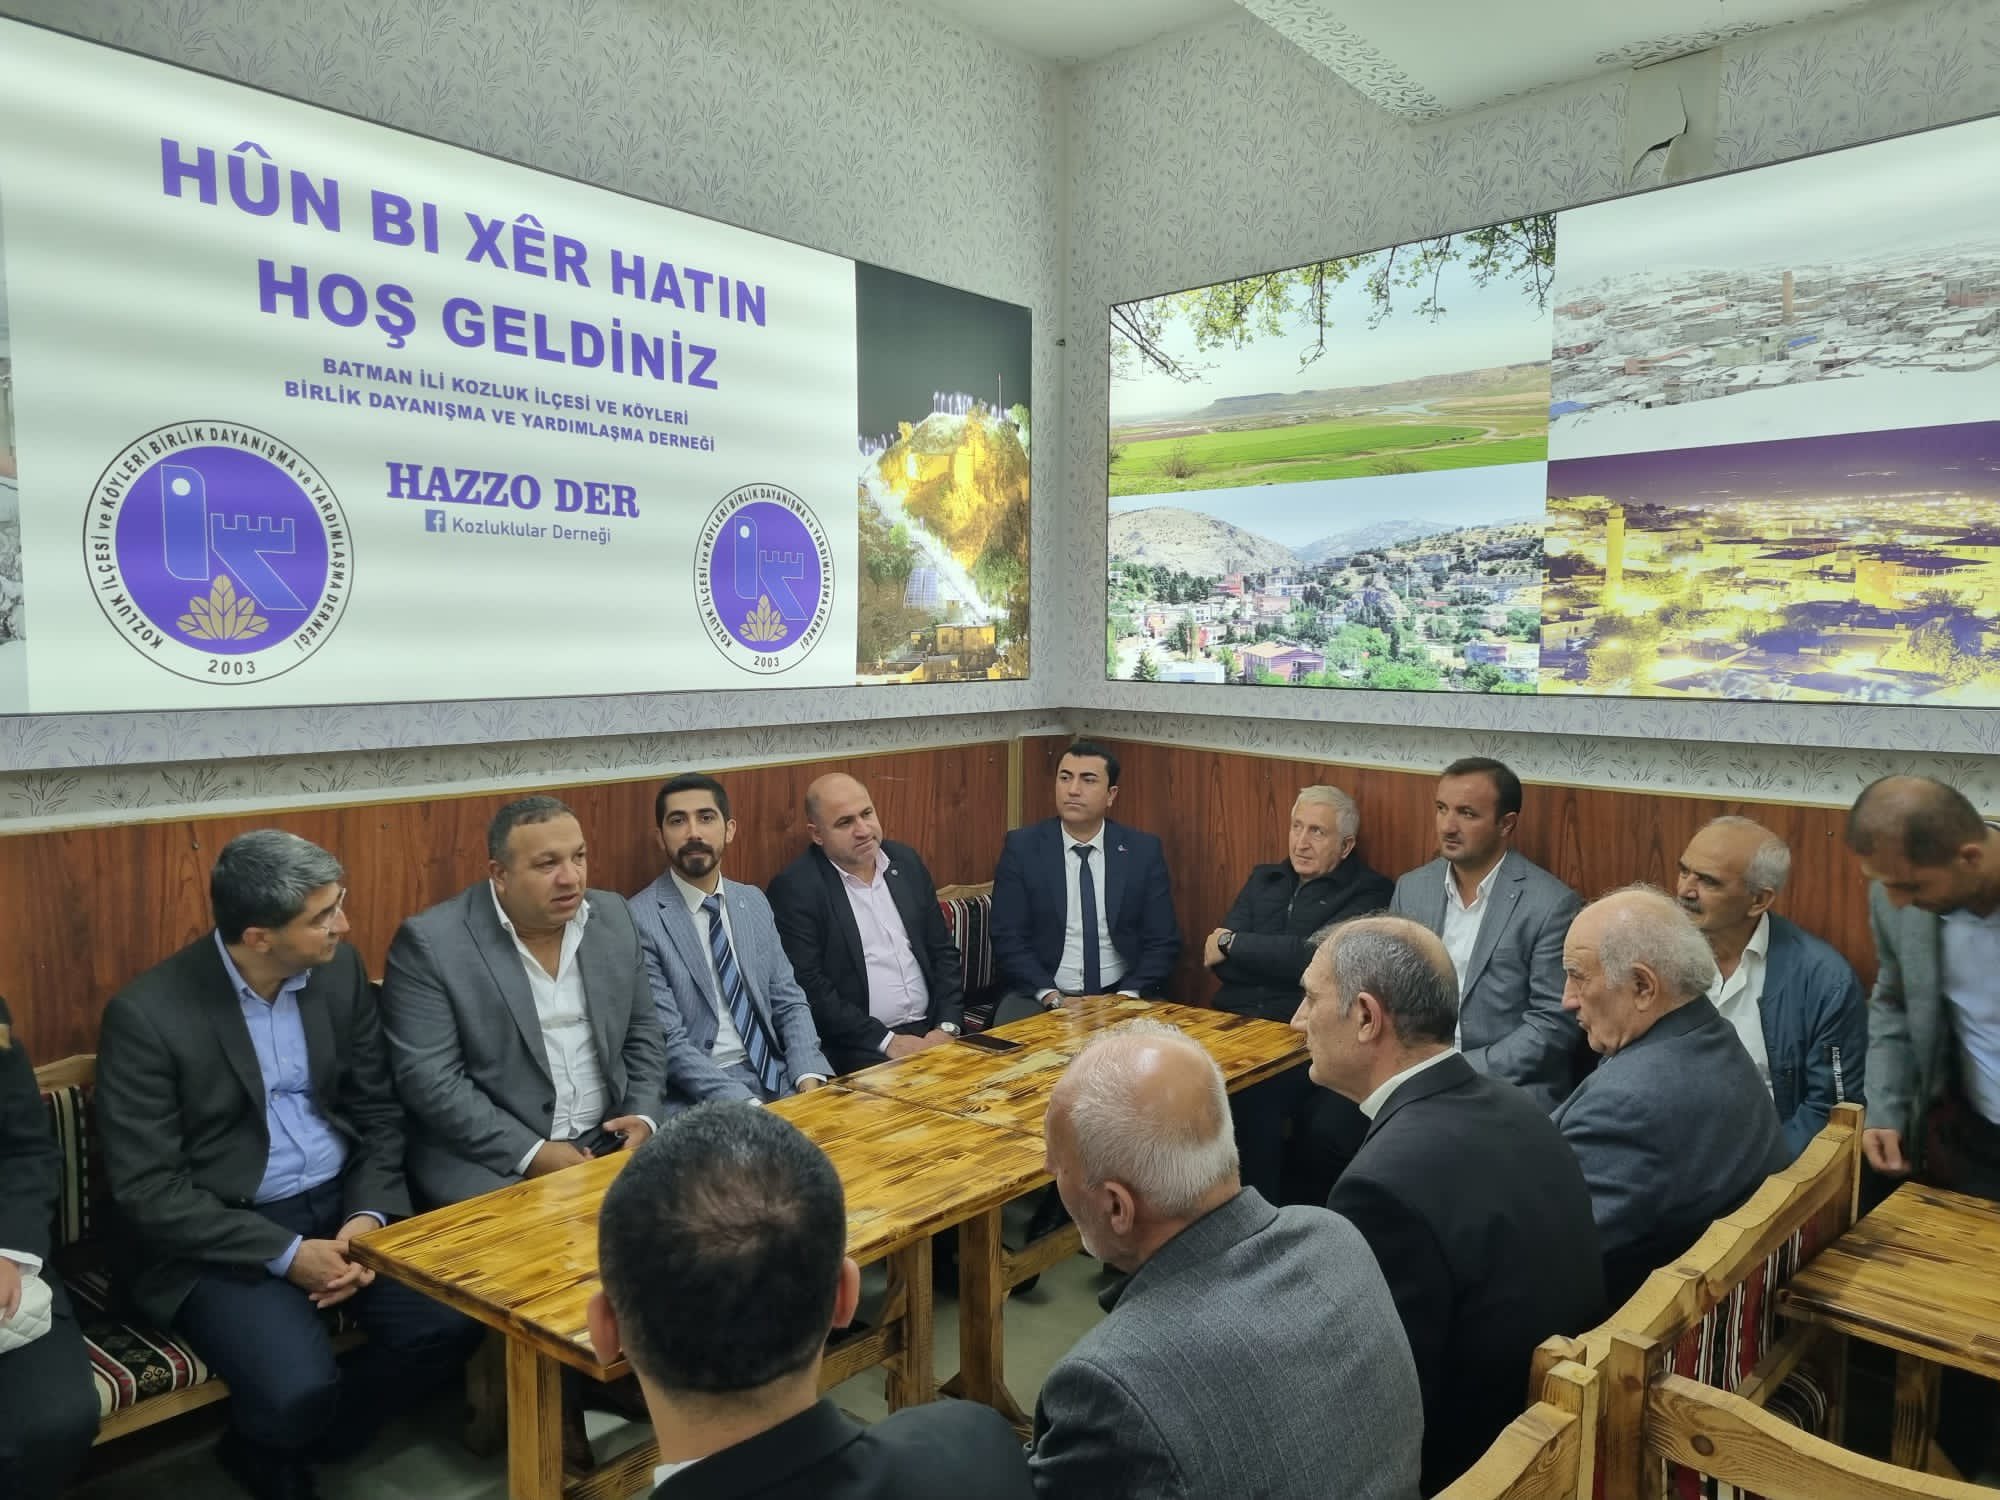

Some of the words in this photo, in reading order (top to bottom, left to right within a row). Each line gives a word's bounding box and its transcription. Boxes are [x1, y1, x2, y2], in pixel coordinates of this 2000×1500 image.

[160, 137, 341, 233] HÛN
[371, 189, 439, 254] BI
[464, 212, 592, 288] XÊR
[611, 249, 766, 328] HATIN
[258, 258, 417, 349] HOŞ
[442, 297, 719, 391] GELDİNİZ
[285, 379, 362, 406] BİRLİK
[369, 392, 486, 422] DAYANIŞMA
[491, 409, 516, 426] VE
[522, 413, 644, 442] YARDIMLAŞMA
[649, 431, 715, 452] DERNEĞİ
[323, 357, 413, 385] BATMAN
[420, 369, 445, 390] İLİ
[452, 377, 529, 402] KOZLUK
[535, 387, 591, 411] İLÇESİ
[596, 399, 617, 415] VE
[622, 403, 689, 426] KÖYLERİ
[149, 425, 205, 455] BİRLİK
[210, 428, 296, 470] DAYANIŞMA
[100, 446, 151, 510] KÖYLERİ
[297, 470, 312, 485] ve
[385, 461, 541, 510] HAZZO
[554, 478, 640, 518] DER
[100, 513, 112, 531] ve
[311, 484, 345, 590] YARDIMLAŞMA
[452, 516, 547, 539] Kozluklular
[553, 524, 611, 545] Derneği
[91, 535, 118, 591] İLÇESİ
[110, 593, 164, 650] KOZLUK
[293, 593, 339, 651] DERNEĞİ
[706, 609, 732, 649] KOZLUK
[207, 659, 256, 676] 2003
[754, 655, 779, 668] 2003
